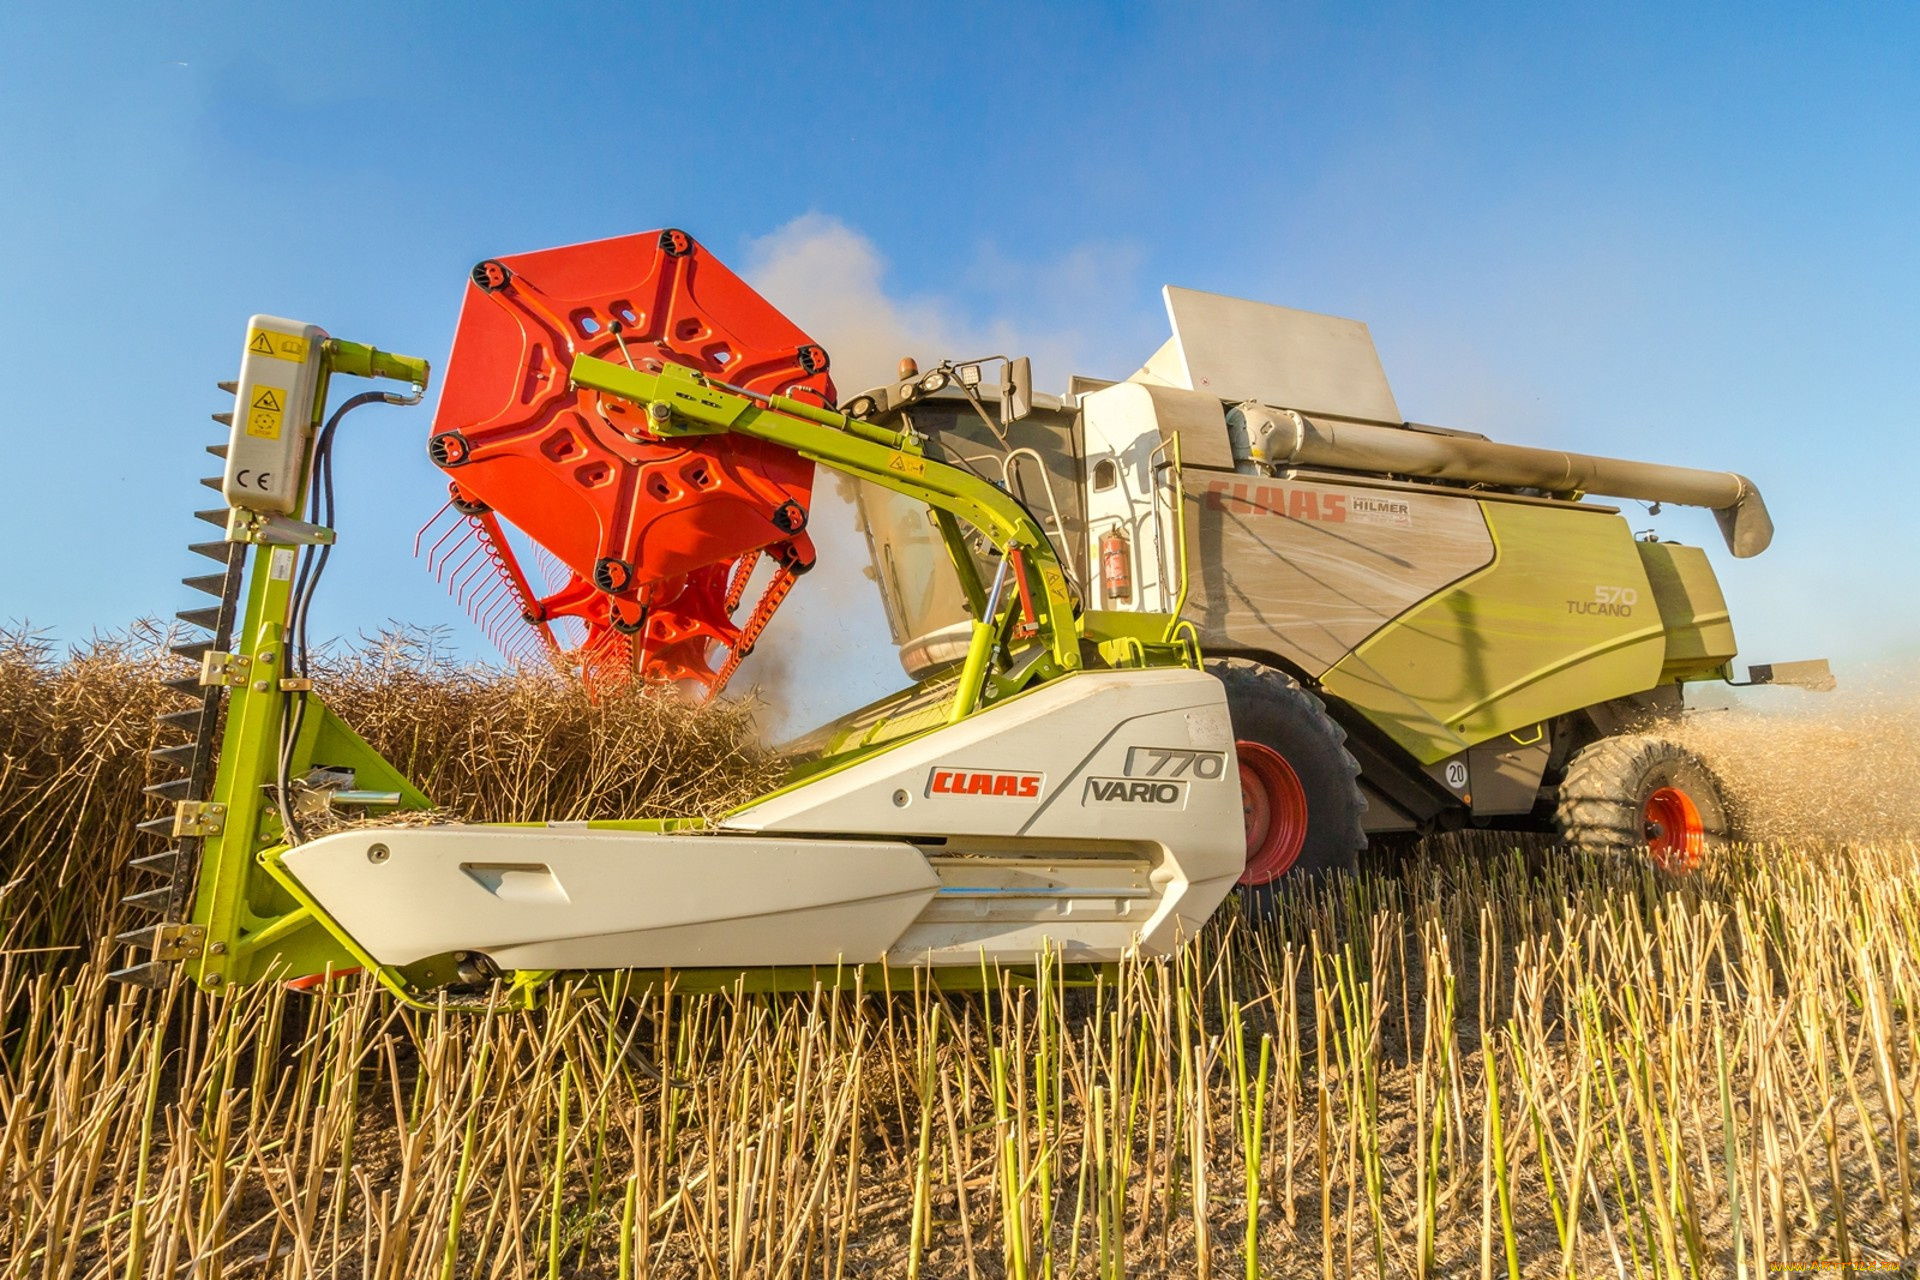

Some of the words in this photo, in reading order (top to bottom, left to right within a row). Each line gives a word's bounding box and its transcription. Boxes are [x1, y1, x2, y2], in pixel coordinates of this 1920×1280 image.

[1206, 480, 1347, 524] CLAAS
[1353, 501, 1409, 514] HILMER
[1595, 585, 1637, 606] 570
[1567, 600, 1632, 617] TUCANO
[1146, 750, 1223, 780] 770
[1449, 764, 1464, 783] 20
[931, 771, 1040, 798] CLAAS
[1091, 780, 1180, 804] VARIO
